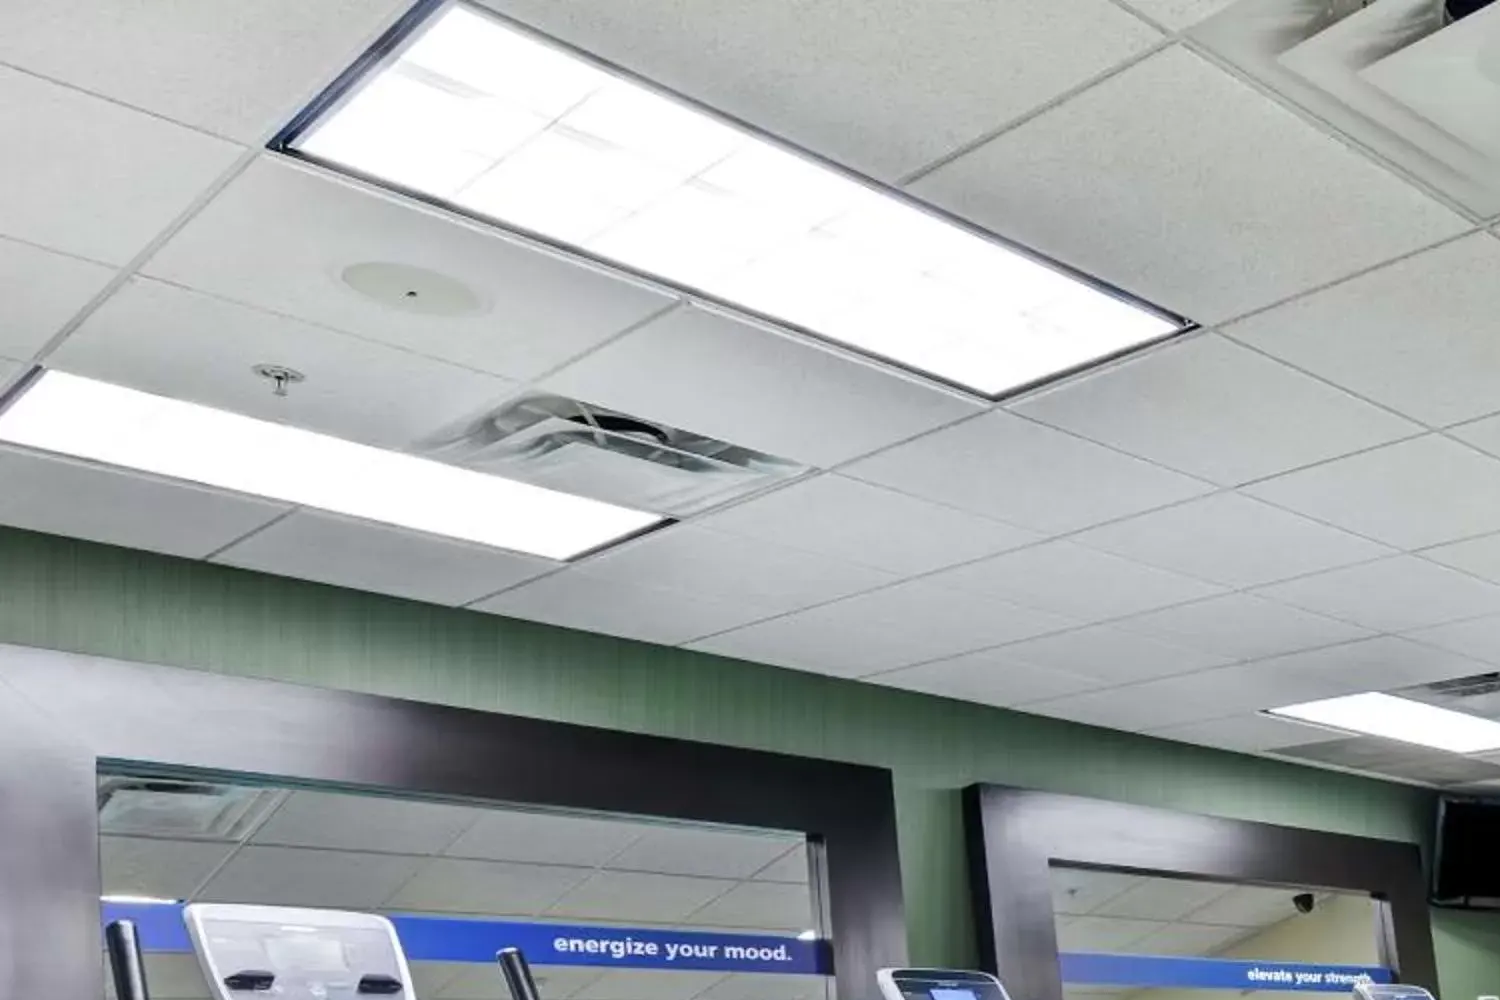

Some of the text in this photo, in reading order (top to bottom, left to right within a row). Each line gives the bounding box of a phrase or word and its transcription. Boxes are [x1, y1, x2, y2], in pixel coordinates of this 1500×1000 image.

[553, 937, 793, 962] energize your mood.
[1247, 967, 1293, 982] elevate
[1295, 973, 1323, 985] your
